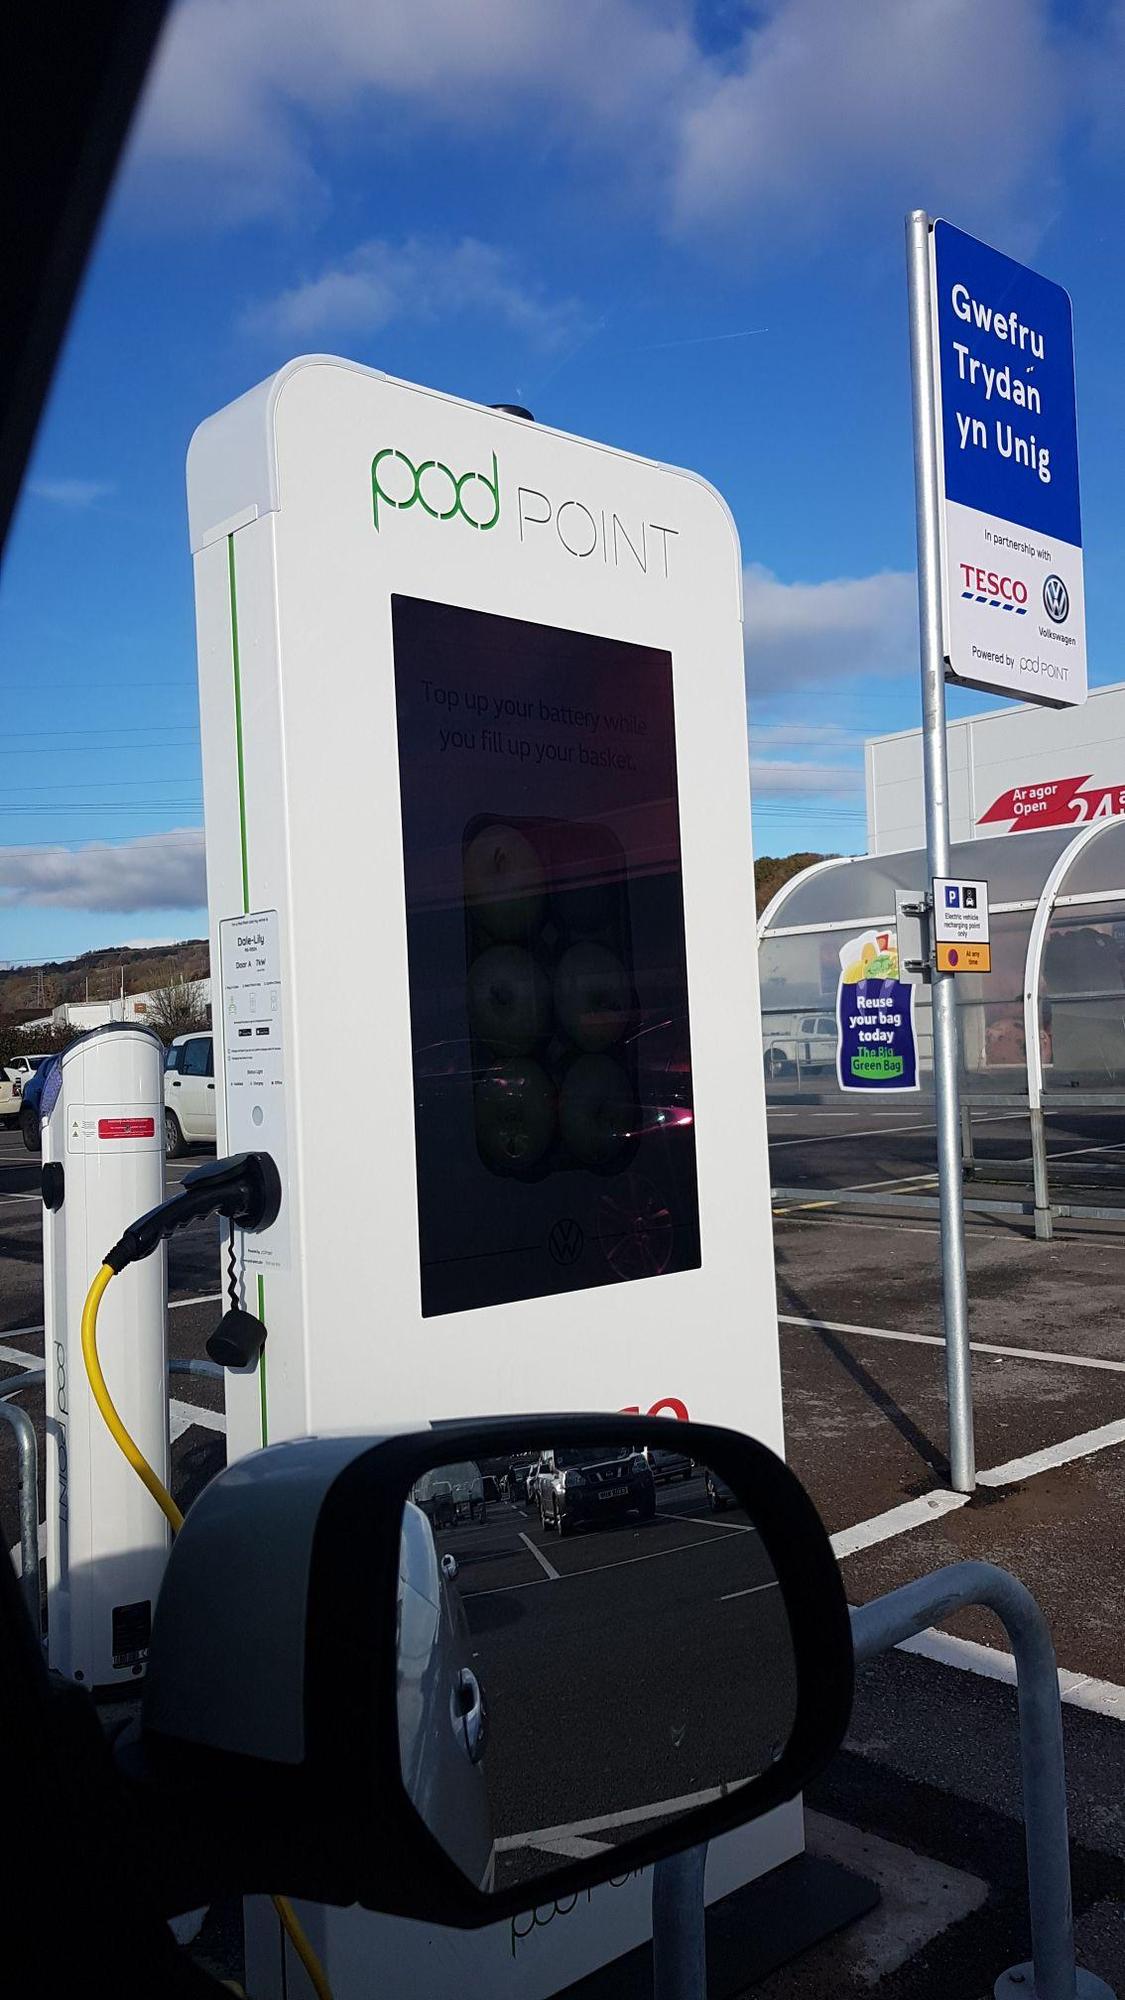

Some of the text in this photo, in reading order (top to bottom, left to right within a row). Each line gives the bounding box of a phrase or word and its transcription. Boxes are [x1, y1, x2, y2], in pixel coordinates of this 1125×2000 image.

[951, 283, 1045, 360] Gwefru
[953, 341, 1042, 415] Trydan
[956, 412, 1051, 484] yn Unig
[371, 448, 679, 579] pod POINT
[984, 529, 1052, 562] In partnership with
[960, 563, 1028, 604] TESCO
[1038, 626, 1077, 646] Volkswagen
[971, 645, 1069, 681] Powered by pod POINT
[421, 680, 648, 736] Top up your battery while
[439, 728, 637, 771] you fill up your basket.
[1012, 785, 1058, 801] Ar agor
[1013, 801, 1047, 816] Open
[948, 890, 956, 904] P
[945, 912, 962, 921] Electric
[943, 921, 981, 930] recharging point
[957, 930, 968, 938] only
[857, 995, 893, 1009] Reuse
[849, 1012, 902, 1028] your bag
[858, 1030, 894, 1044] today
[857, 1046, 894, 1057] The Big
[852, 1058, 901, 1072] Green Bag
